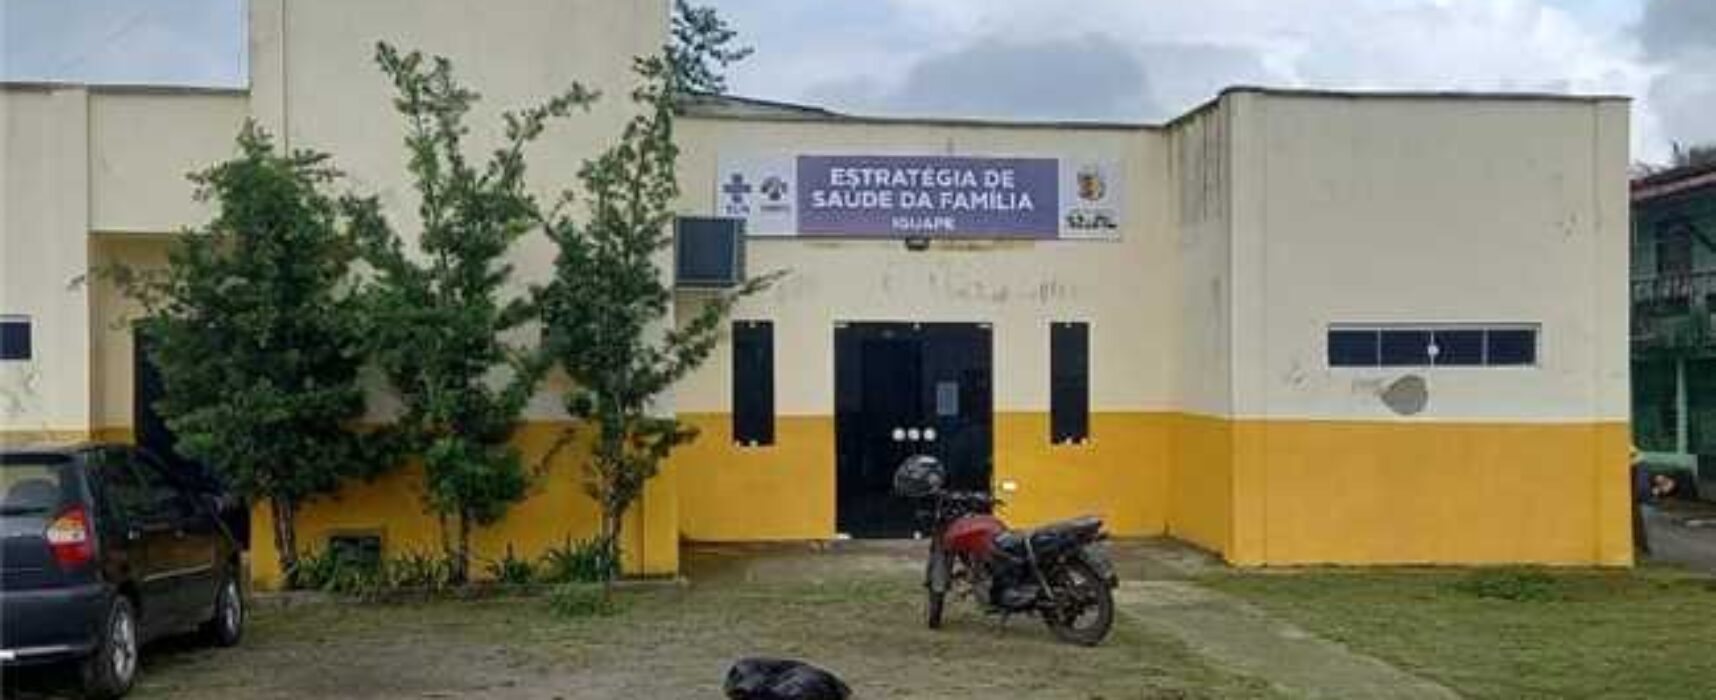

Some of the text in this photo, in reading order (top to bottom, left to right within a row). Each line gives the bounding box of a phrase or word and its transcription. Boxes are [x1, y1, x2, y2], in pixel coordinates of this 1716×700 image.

[830, 166, 1015, 188] ESTRATÉGIA DE
[900, 190, 934, 209] DA
[939, 189, 1034, 211] FAMÍLIA
[891, 215, 955, 231] IGUAPE
